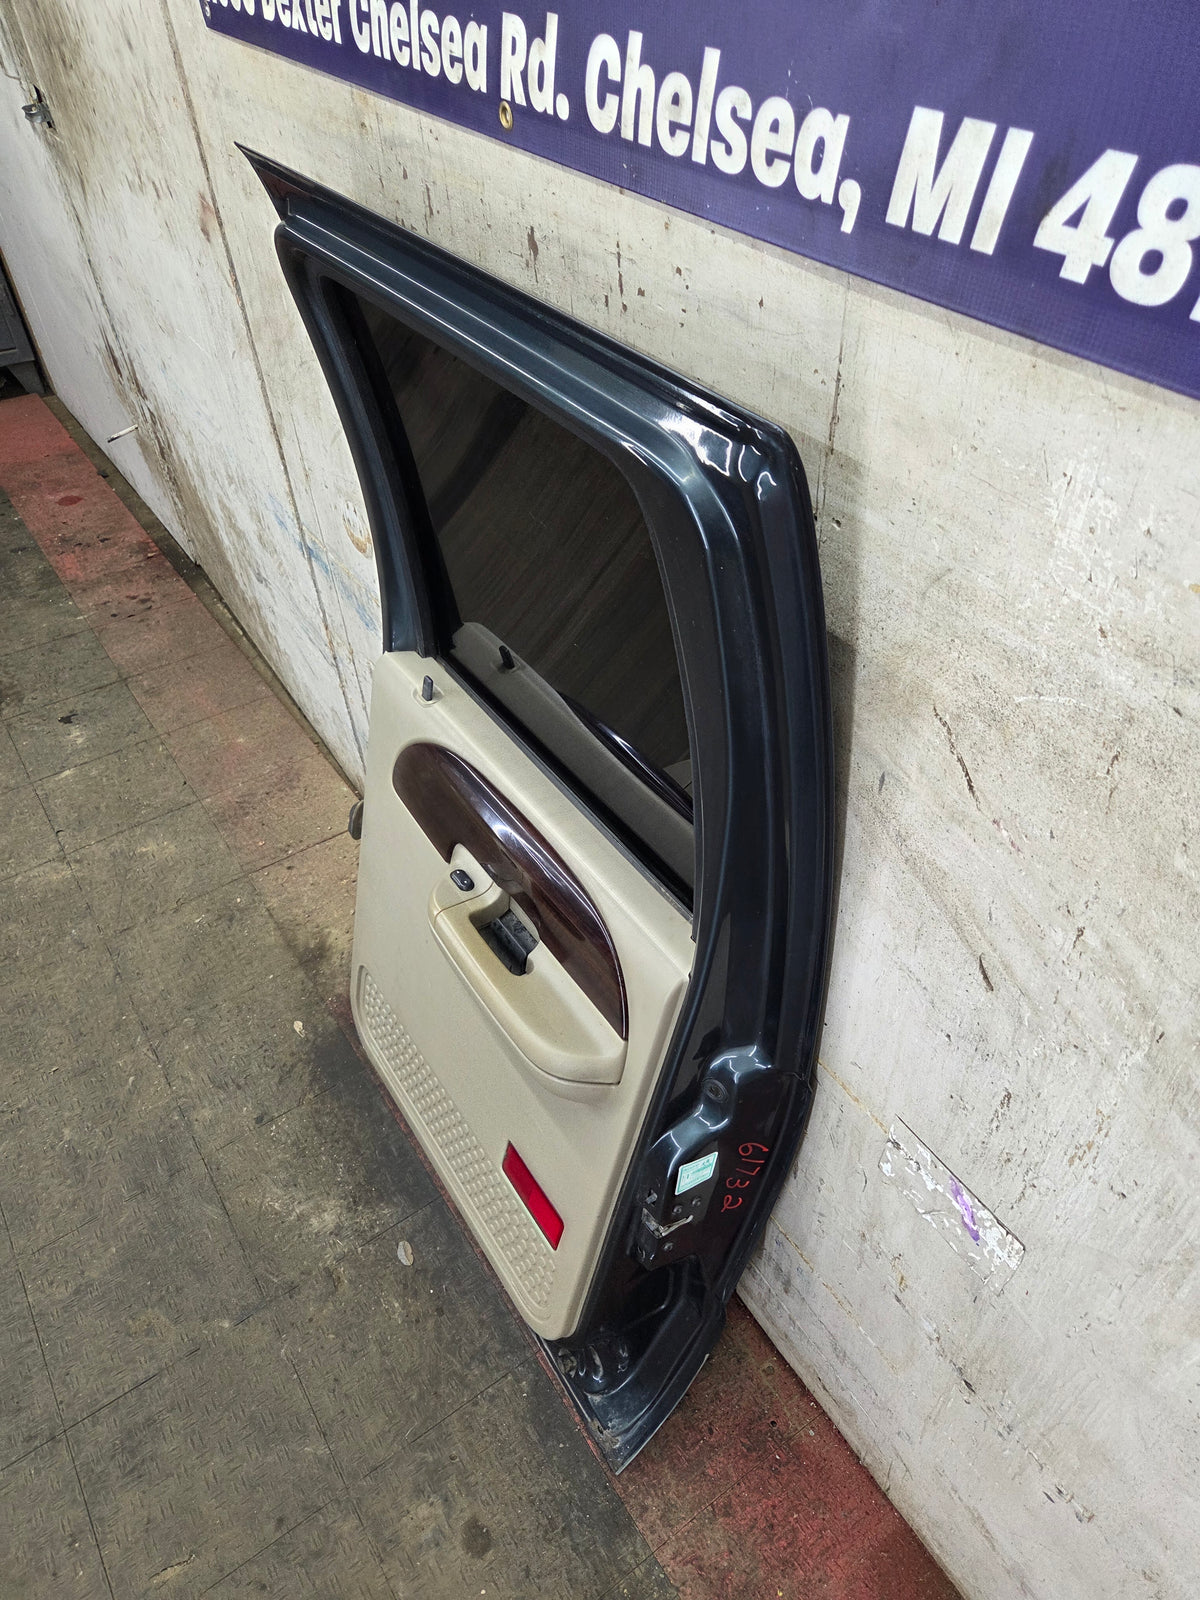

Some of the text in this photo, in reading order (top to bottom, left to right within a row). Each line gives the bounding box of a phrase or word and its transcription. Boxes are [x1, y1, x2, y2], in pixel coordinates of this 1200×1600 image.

[348, 0, 488, 93] Chelsea
[501, 12, 569, 120] Rd.
[585, 30, 862, 234] Chelsea,
[885, 105, 1034, 255] MI
[1033, 149, 1200, 323] 48
[721, 1142, 769, 1212] 61732
